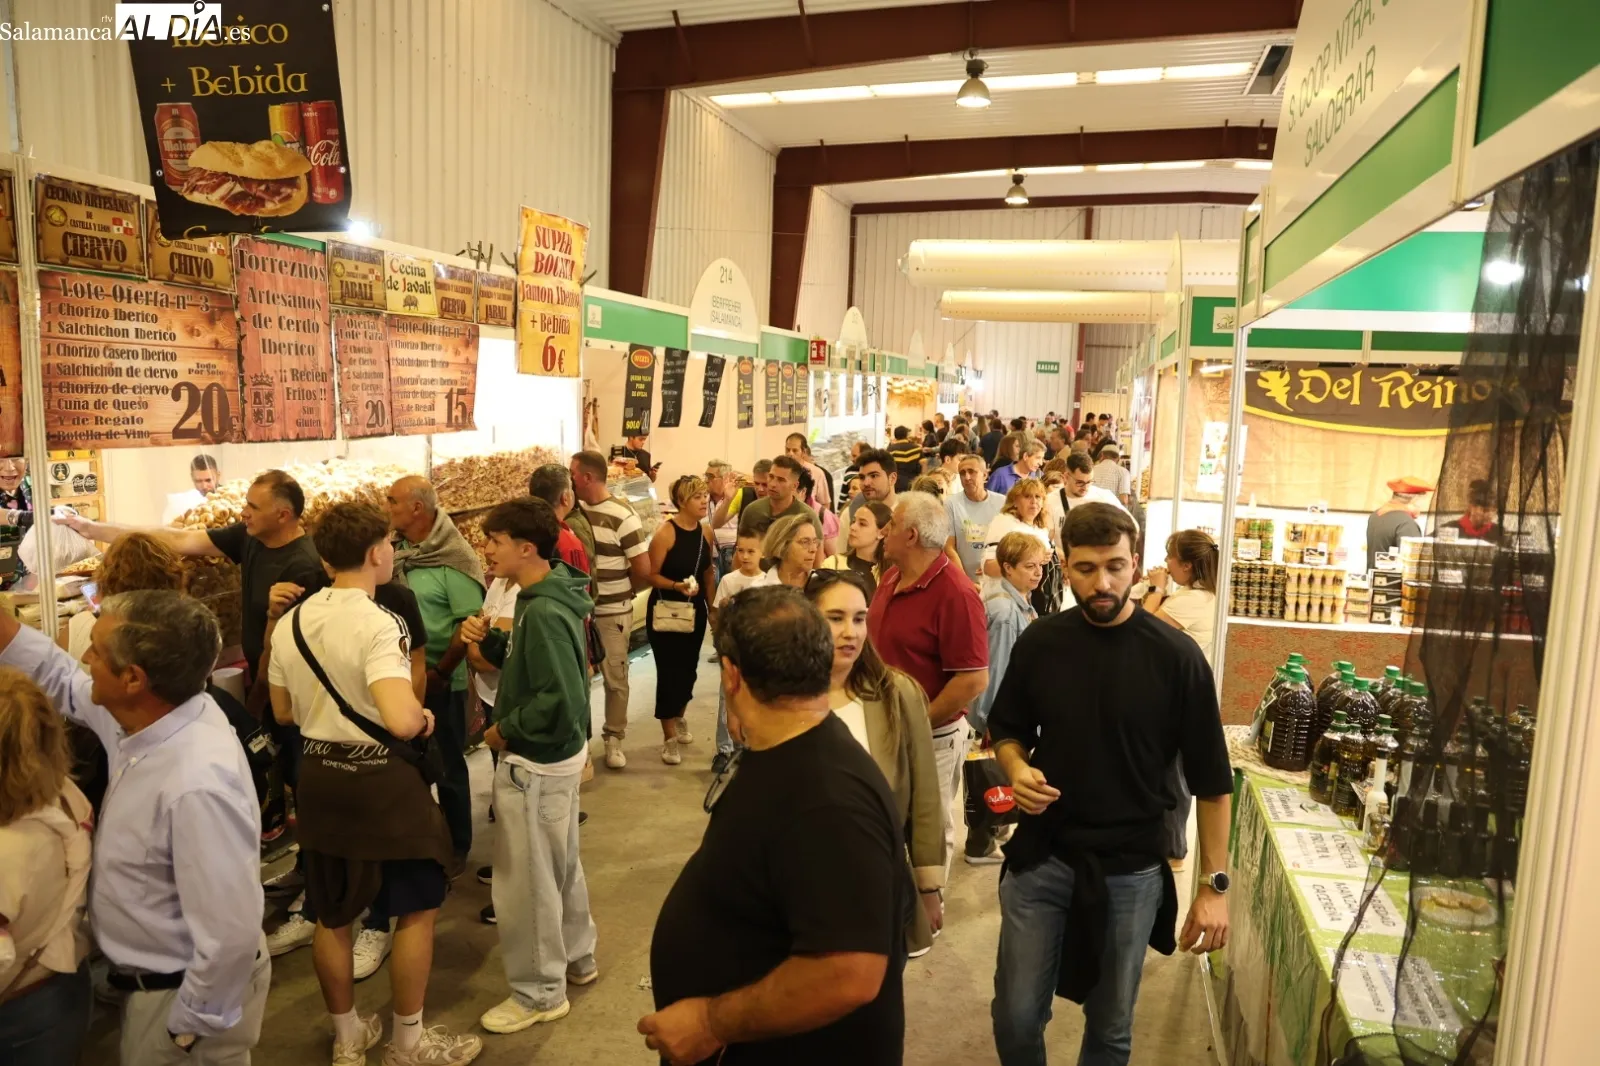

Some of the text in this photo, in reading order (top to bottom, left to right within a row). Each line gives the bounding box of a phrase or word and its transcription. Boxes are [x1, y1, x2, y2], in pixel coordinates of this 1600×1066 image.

[188, 63, 309, 97] Bebida
[1300, 42, 1331, 118] COOP.
[1305, 44, 1376, 168] SALOBRAR
[61, 231, 128, 263] CIERVO
[535, 225, 573, 256] SUPER
[169, 251, 214, 280] CHIVO
[235, 248, 326, 282] Torreznos
[390, 256, 426, 278] Cecina
[720, 265, 733, 284] 214
[386, 274, 400, 291] de
[60, 278, 105, 301] Lote
[112, 284, 170, 310] Oferta
[200, 295, 210, 313] 3
[247, 286, 322, 312] Artesanos
[58, 302, 110, 320] Chorizo
[114, 307, 158, 324] Iberico
[252, 312, 320, 334] de Cerdo
[134, 326, 177, 342] Iberico
[396, 318, 419, 334] Lote
[56, 342, 100, 359] Chorizo
[126, 365, 141, 378] de
[144, 367, 179, 379] ciervo
[1037, 363, 1058, 371] SALIDA
[58, 381, 109, 395] Chorizo
[112, 382, 129, 395] de
[132, 383, 169, 396] ciervo
[285, 387, 318, 401] Fritos
[1295, 368, 1362, 406] Del
[93, 399, 109, 411] de
[112, 399, 149, 412] Queso
[71, 415, 89, 427] de
[93, 415, 144, 427] Regalo
[296, 418, 321, 428] Gluten
[57, 430, 100, 442] Botella
[105, 431, 121, 441] de
[124, 429, 150, 440] Vino
